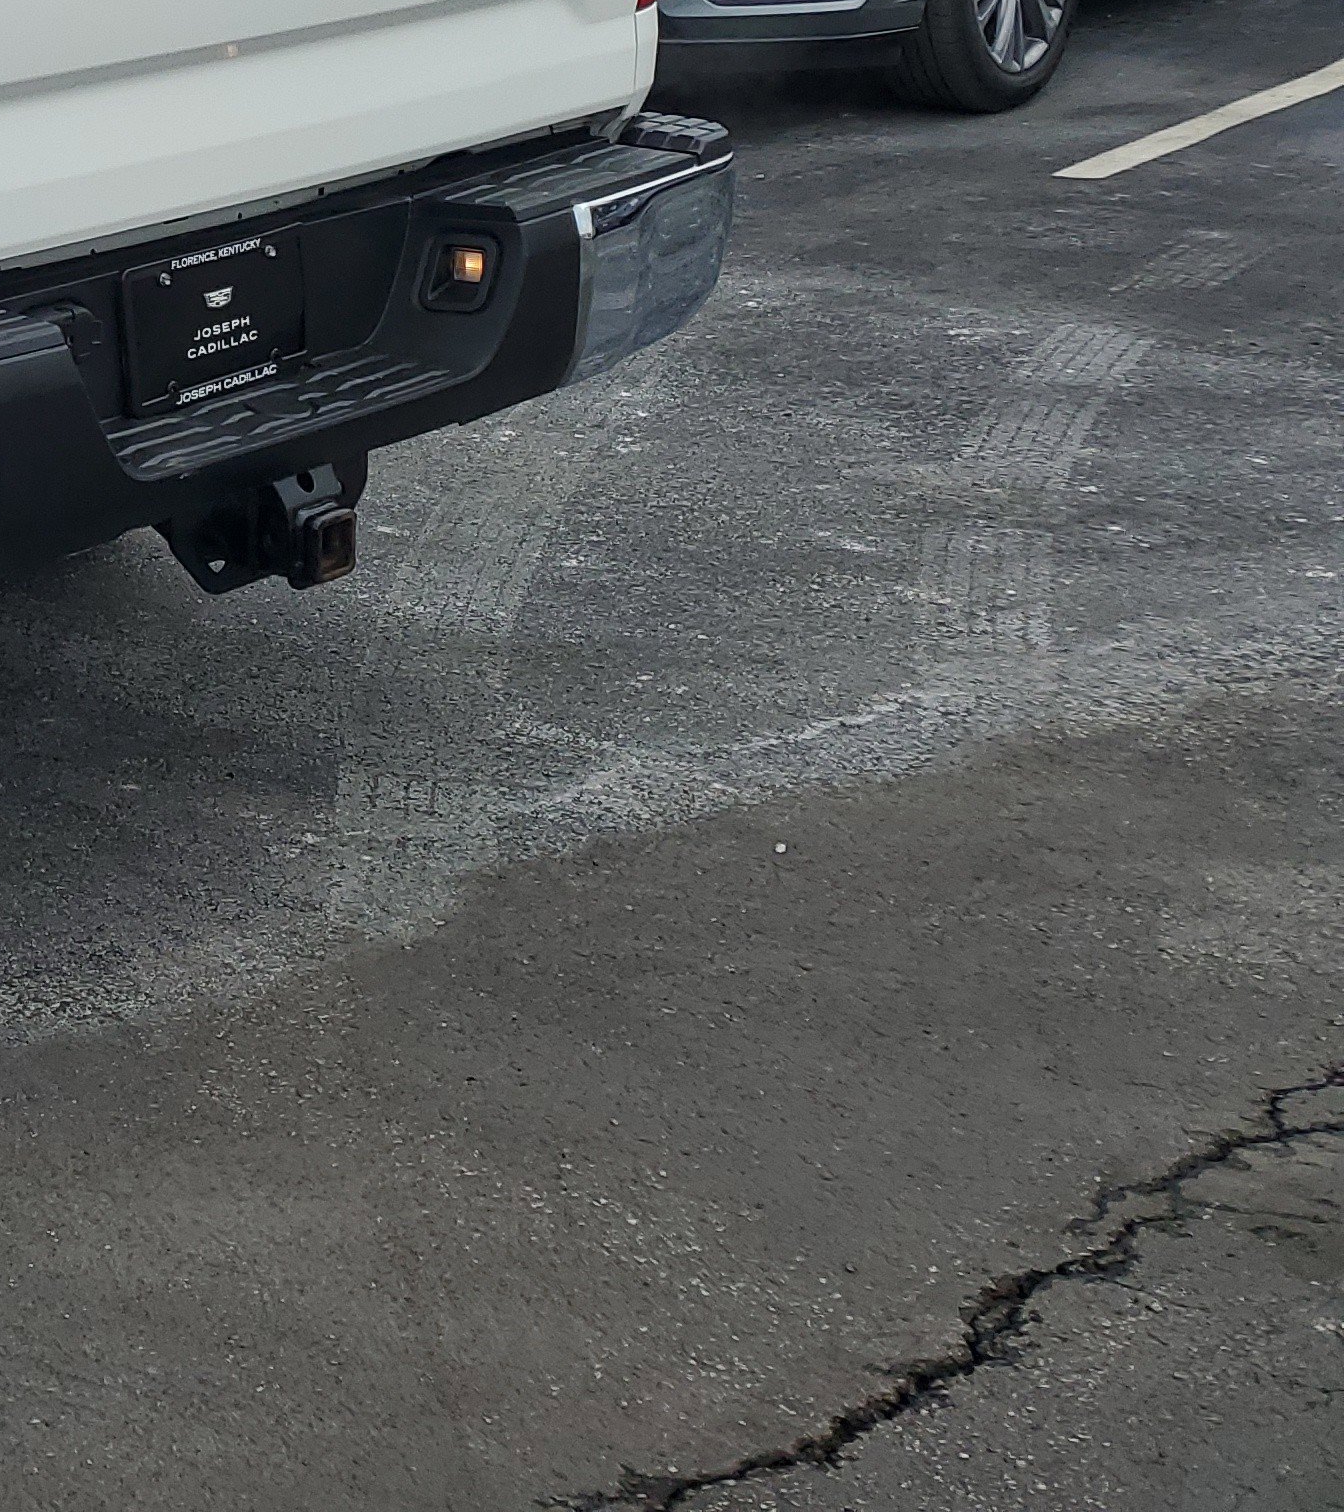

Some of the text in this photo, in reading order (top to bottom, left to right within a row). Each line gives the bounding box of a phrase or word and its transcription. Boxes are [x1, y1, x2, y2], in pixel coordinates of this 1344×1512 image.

[170, 238, 262, 270] FLORENCE, KENTUCKY
[193, 315, 251, 341] JOSEPH
[187, 330, 259, 359] CADILLAC
[175, 364, 278, 405] JOSEPH CADILLAC
